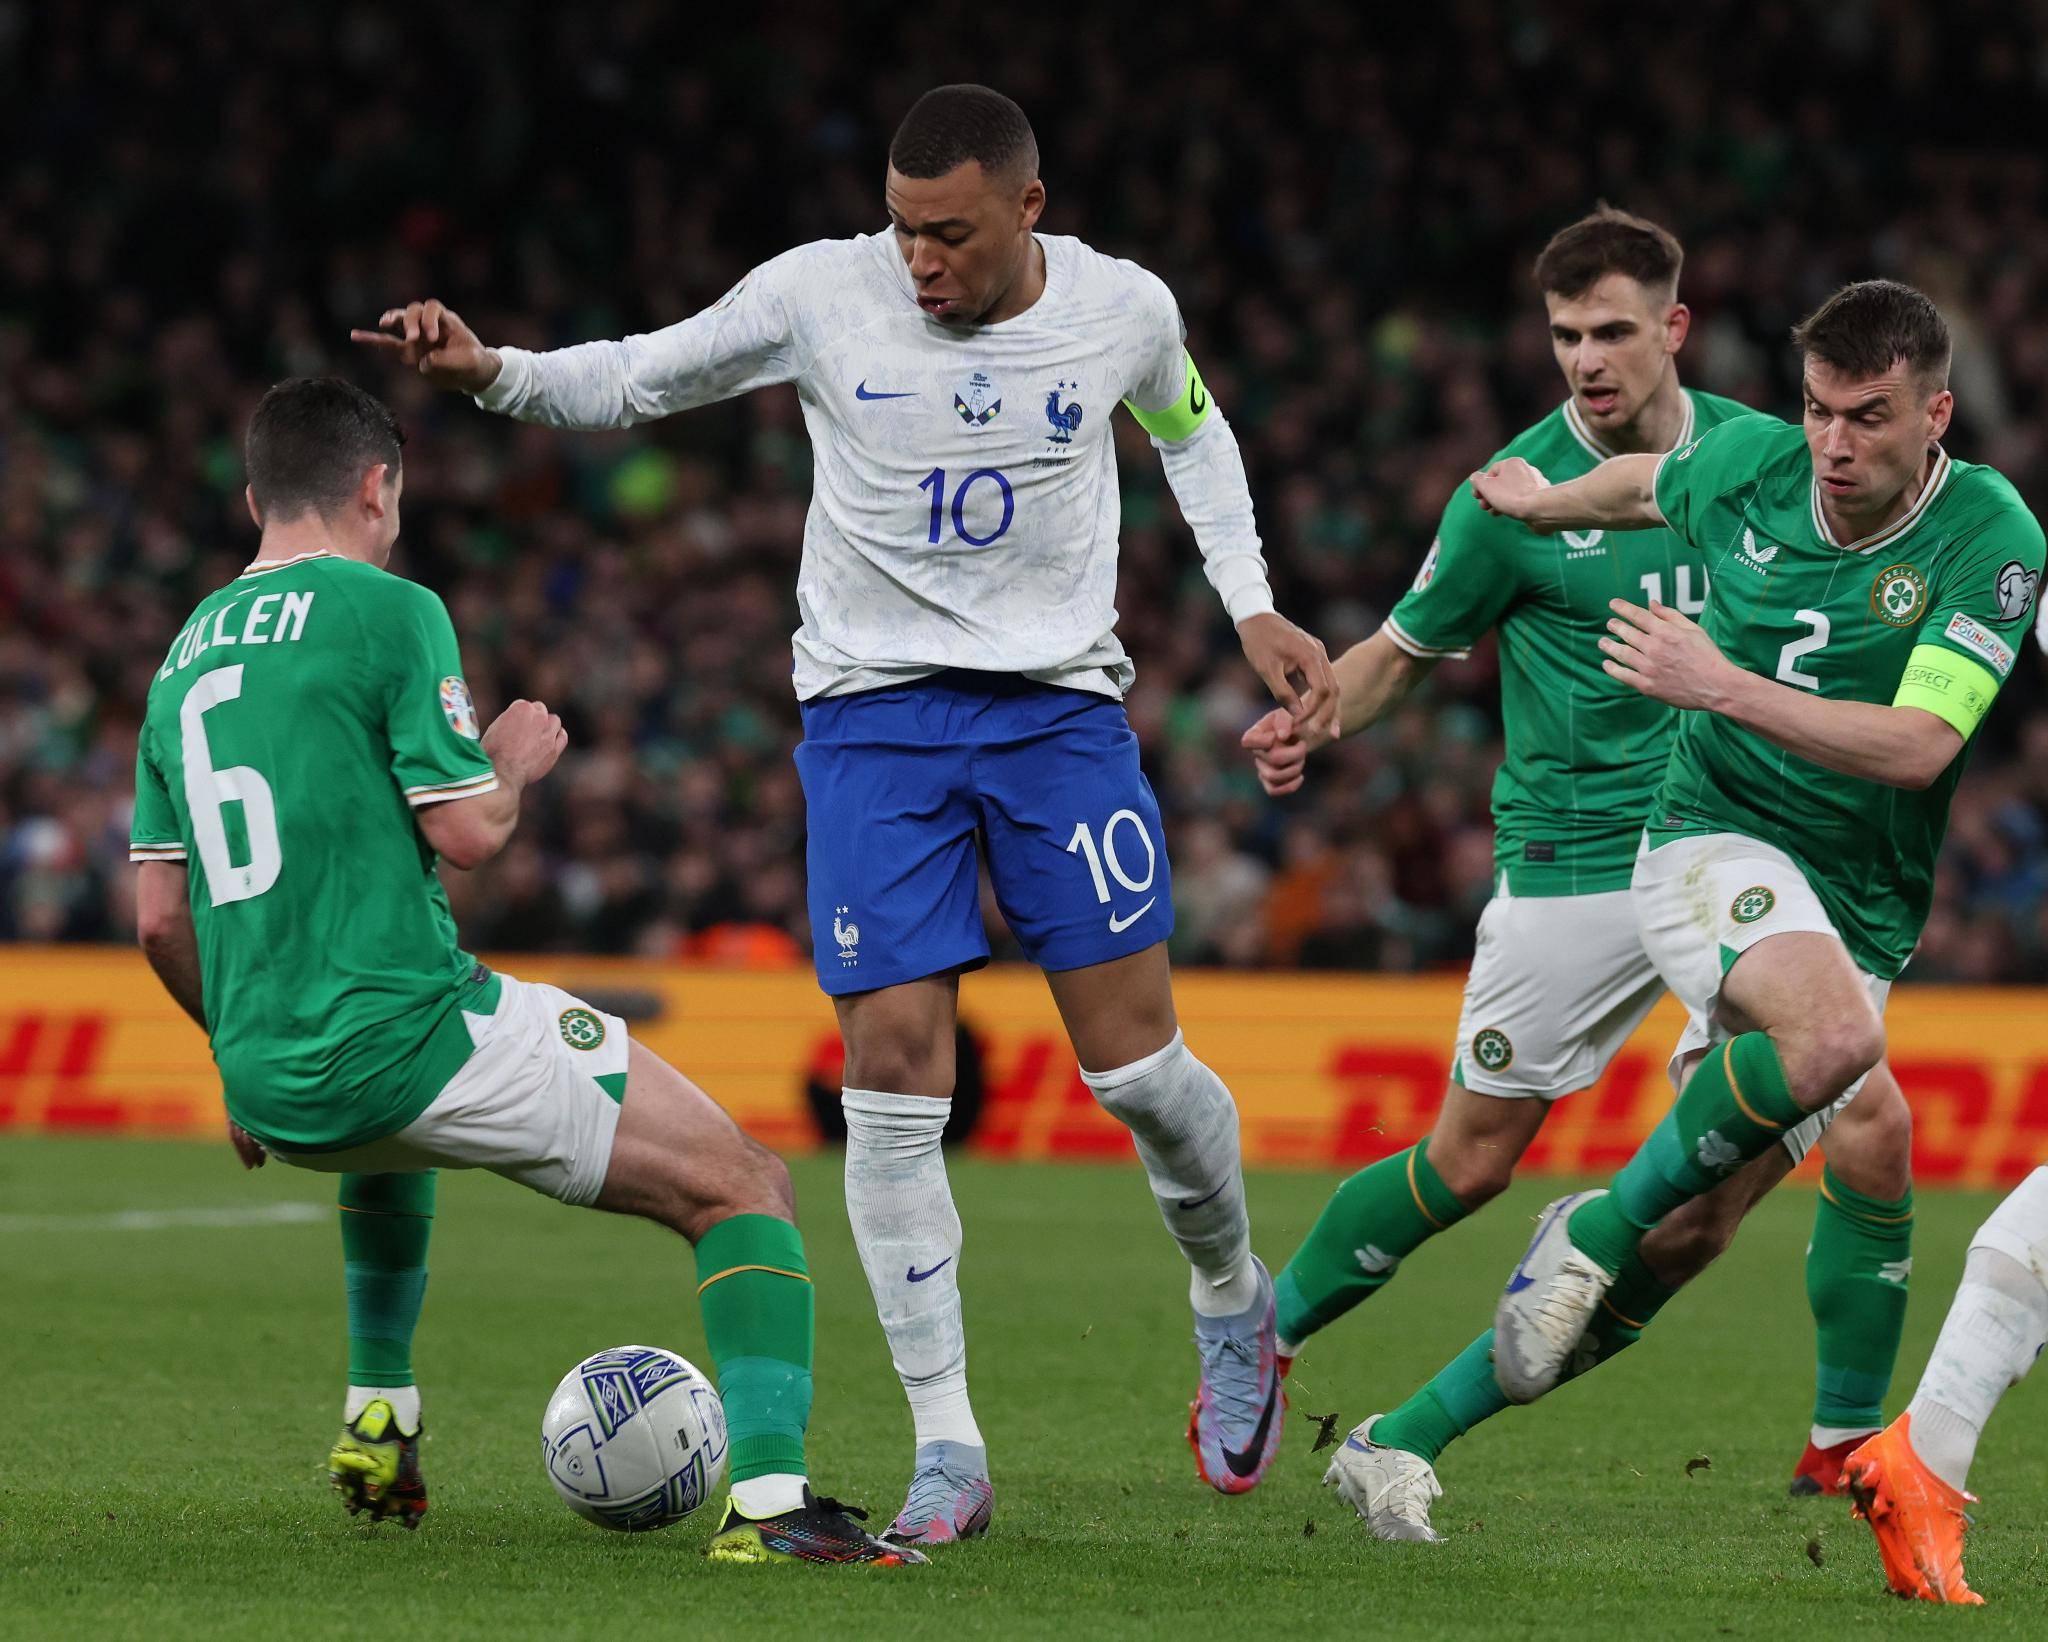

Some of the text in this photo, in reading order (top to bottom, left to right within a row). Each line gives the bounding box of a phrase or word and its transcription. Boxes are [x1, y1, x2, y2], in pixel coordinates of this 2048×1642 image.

[918, 466, 1014, 546] 10
[1734, 552, 1768, 577] CASTORE
[1879, 568, 1924, 591] IRELAND
[160, 591, 315, 682] CULLEN
[1776, 610, 1830, 690] 2
[180, 663, 282, 908] 6
[1066, 809, 1156, 904] 10
